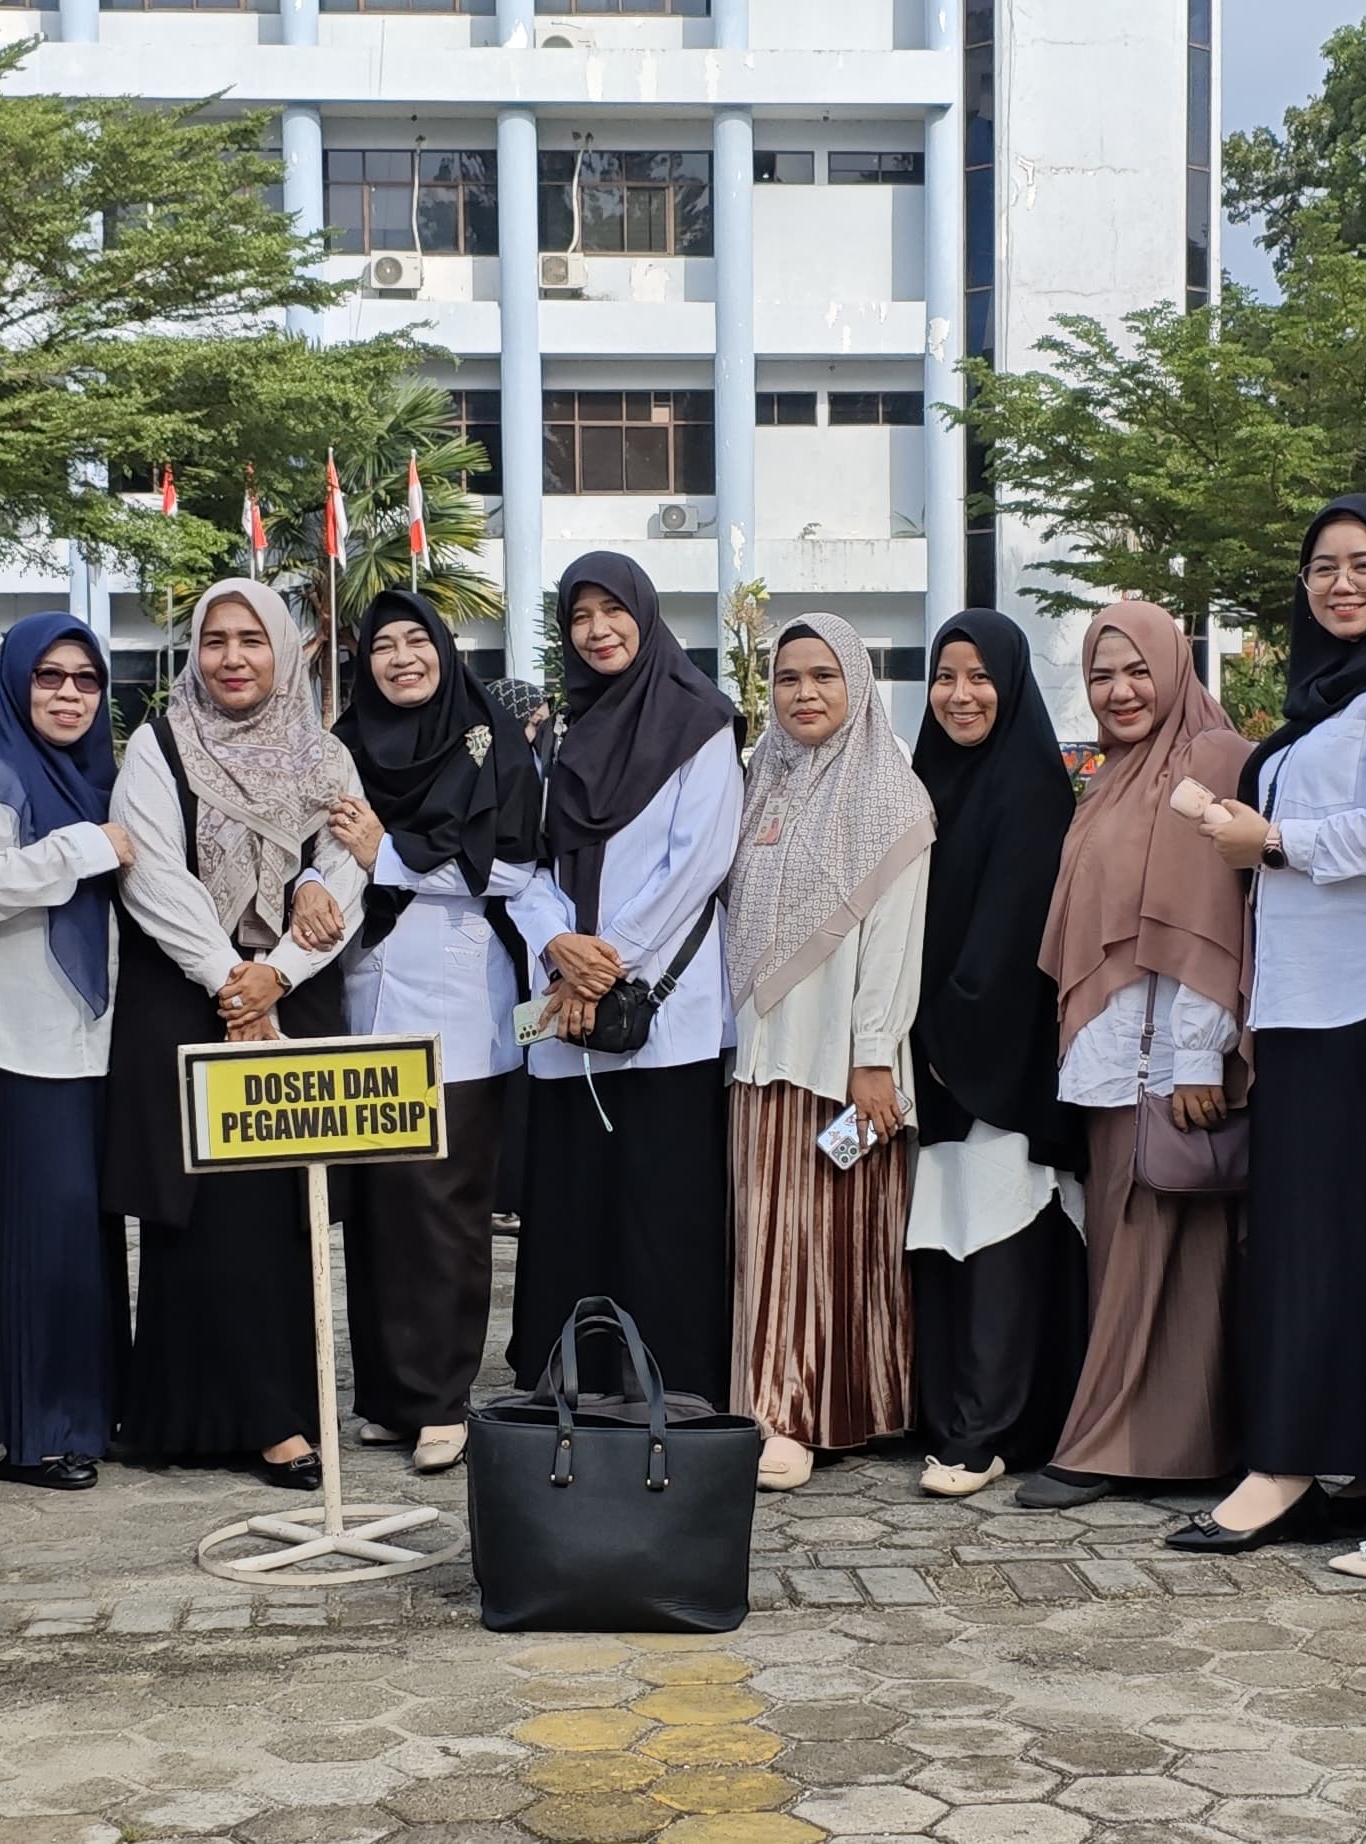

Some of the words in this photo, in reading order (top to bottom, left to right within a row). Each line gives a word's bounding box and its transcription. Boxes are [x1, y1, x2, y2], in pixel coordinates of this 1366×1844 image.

[244, 1069, 335, 1106] DOSEN
[342, 1066, 399, 1099] DAN
[221, 1105, 348, 1143] PEGAWAI
[356, 1101, 425, 1135] FISIP
